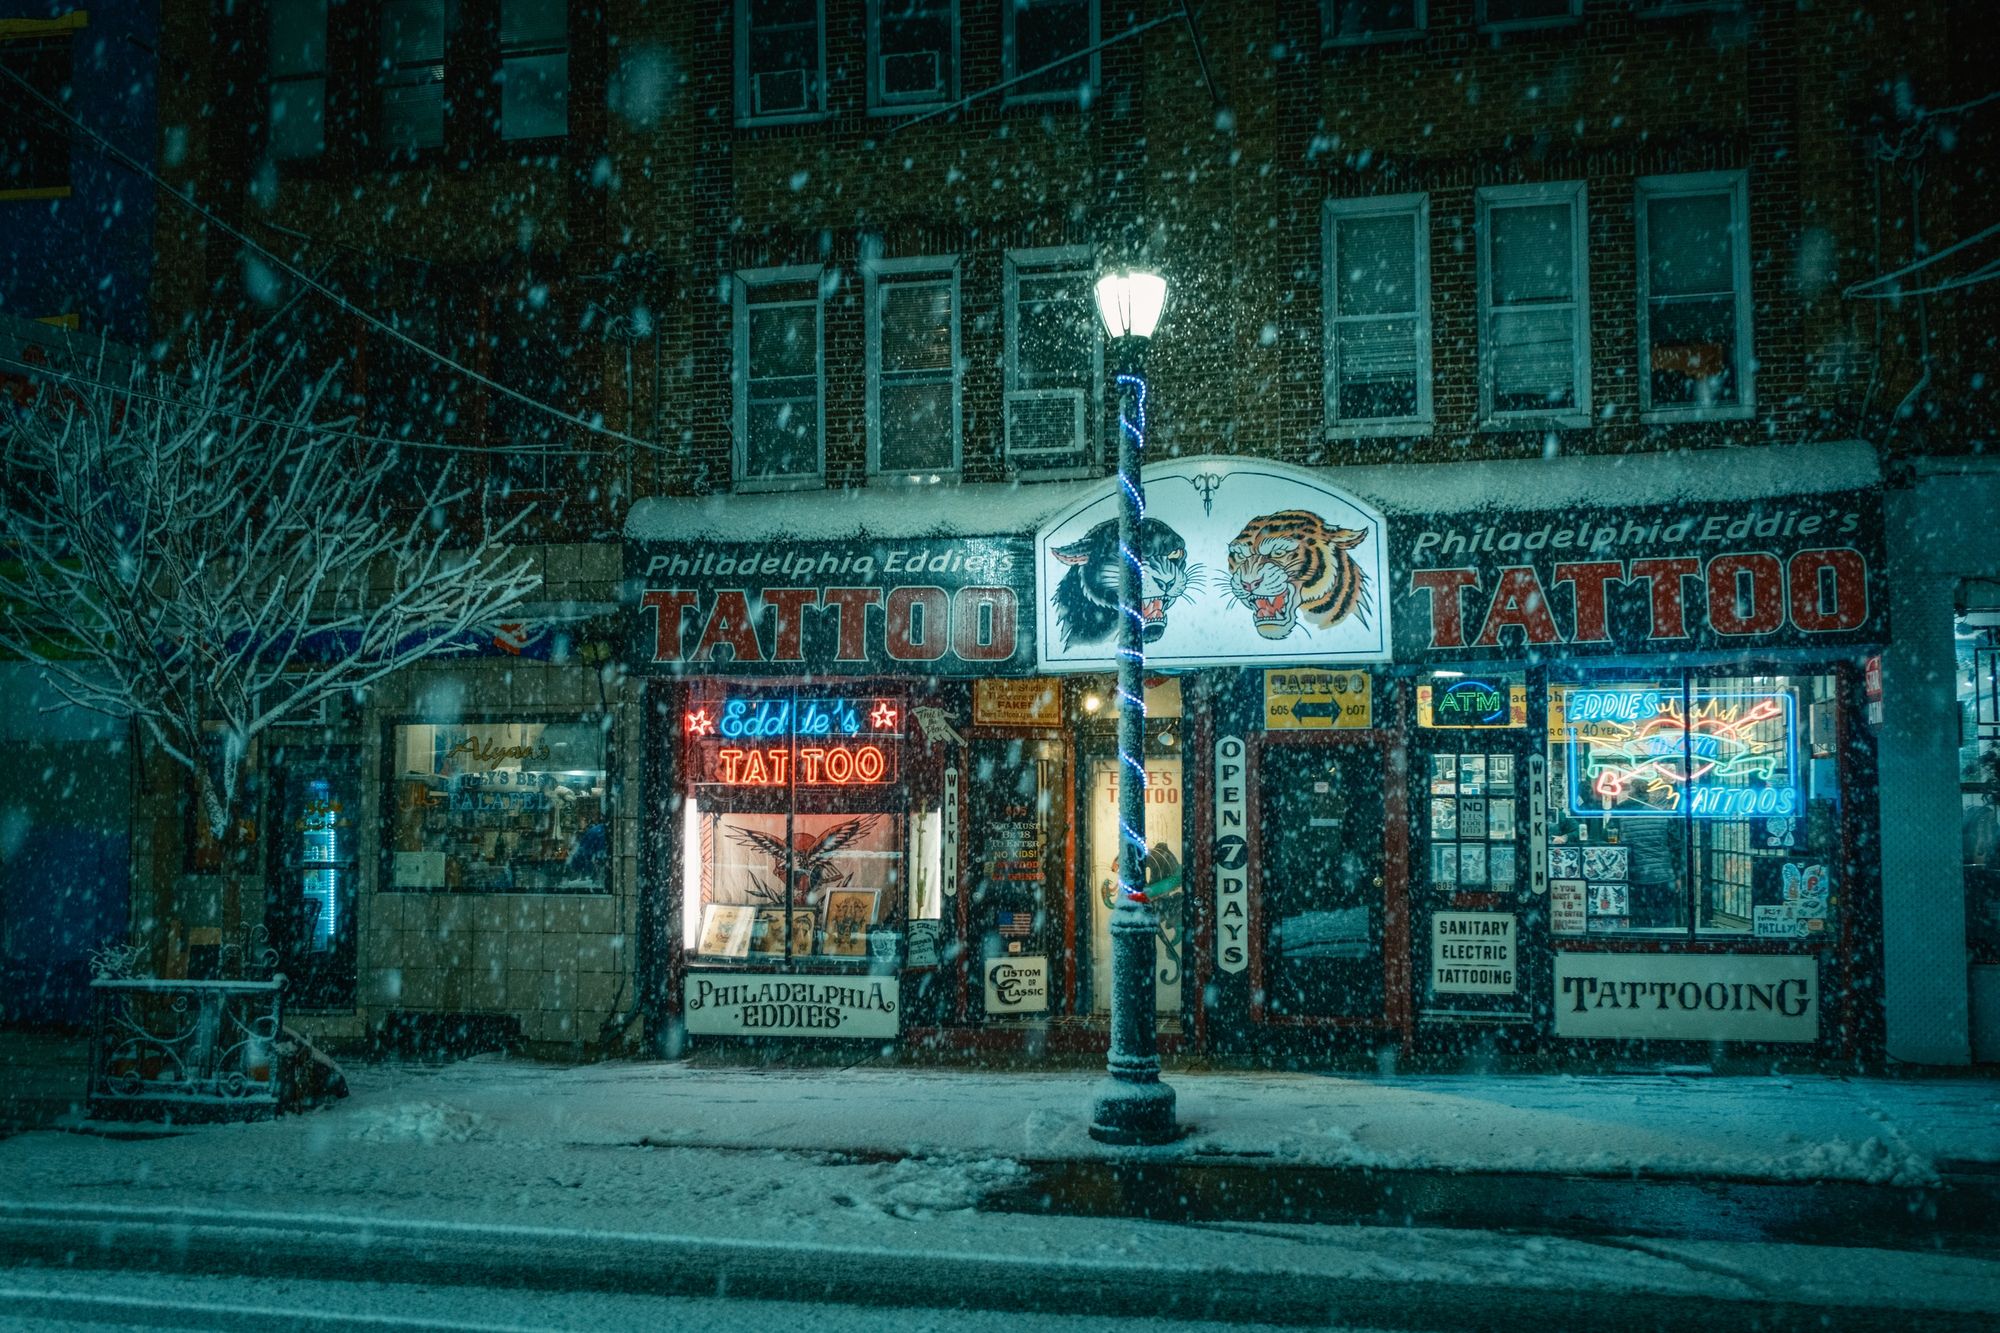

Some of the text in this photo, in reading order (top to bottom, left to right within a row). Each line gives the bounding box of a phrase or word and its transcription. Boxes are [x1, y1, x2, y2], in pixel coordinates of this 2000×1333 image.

[1412, 508, 1860, 555] Philadelphia Eddie's
[646, 549, 1014, 579] Philadelphia Eddie's
[1409, 547, 1870, 650] TATTOO
[638, 585, 1019, 663] TATTOO
[1270, 674, 1365, 695] TATTOO
[1270, 704, 1366, 716] 605 607
[1438, 691, 1501, 712] ATM
[1567, 692, 1659, 721] EDDIES
[720, 698, 860, 737] Eddie's
[1582, 724, 1599, 737] 40
[719, 746, 885, 784] TATTOO
[448, 791, 551, 811] FALAFEL
[1462, 801, 1483, 812] NO
[946, 774, 957, 890] WALK IN
[1532, 760, 1544, 886] WALK IN
[994, 850, 1009, 859] NO
[1007, 840, 1040, 848] ENTER
[1220, 741, 1244, 964] OPEN 7 DAYS
[1439, 920, 1509, 936] SANITARY
[1442, 944, 1507, 961] ELECTRIC
[989, 964, 1041, 991] CUSTOM
[1437, 968, 1512, 985] TATTOOING
[688, 979, 896, 1011] PHILADELPHIA
[996, 978, 1044, 1005] CLASSIC
[1562, 975, 1812, 1017] TATTOOING
[741, 1003, 842, 1029] EDDIE'S
